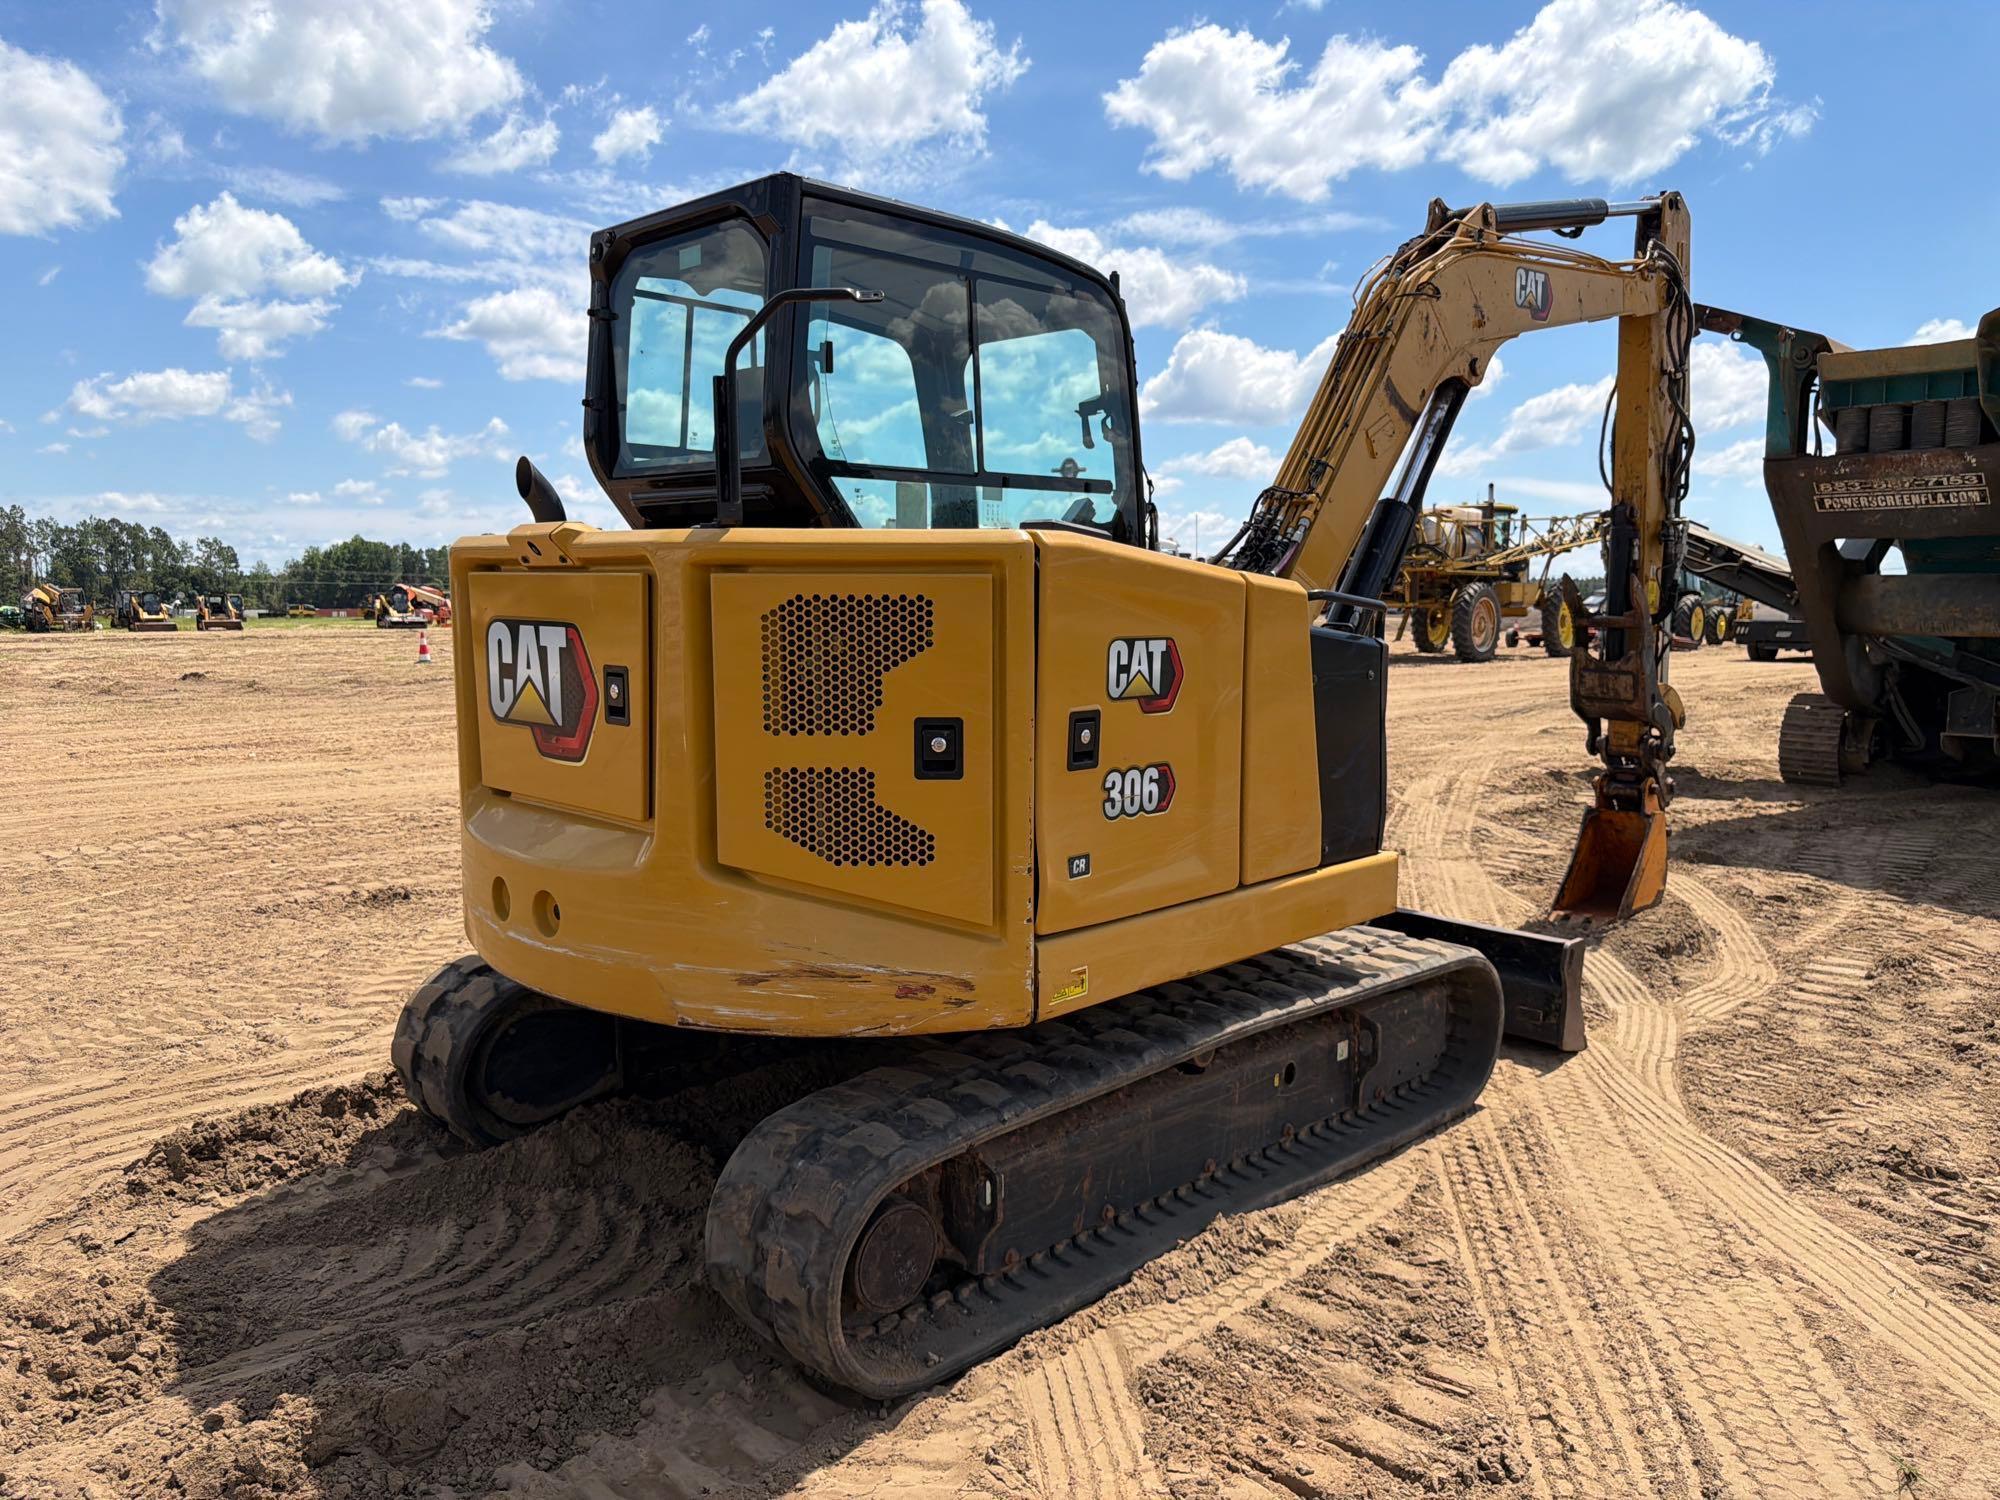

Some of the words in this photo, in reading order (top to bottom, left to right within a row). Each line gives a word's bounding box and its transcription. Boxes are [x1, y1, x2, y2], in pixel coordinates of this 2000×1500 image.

[1516, 267, 1545, 310] CAT
[1824, 490, 1981, 509] POWERSCREENFLA.COM
[488, 621, 566, 727] CAT
[1108, 639, 1166, 699] CAT
[1104, 767, 1159, 817] 306
[1073, 858, 1086, 874] CR
